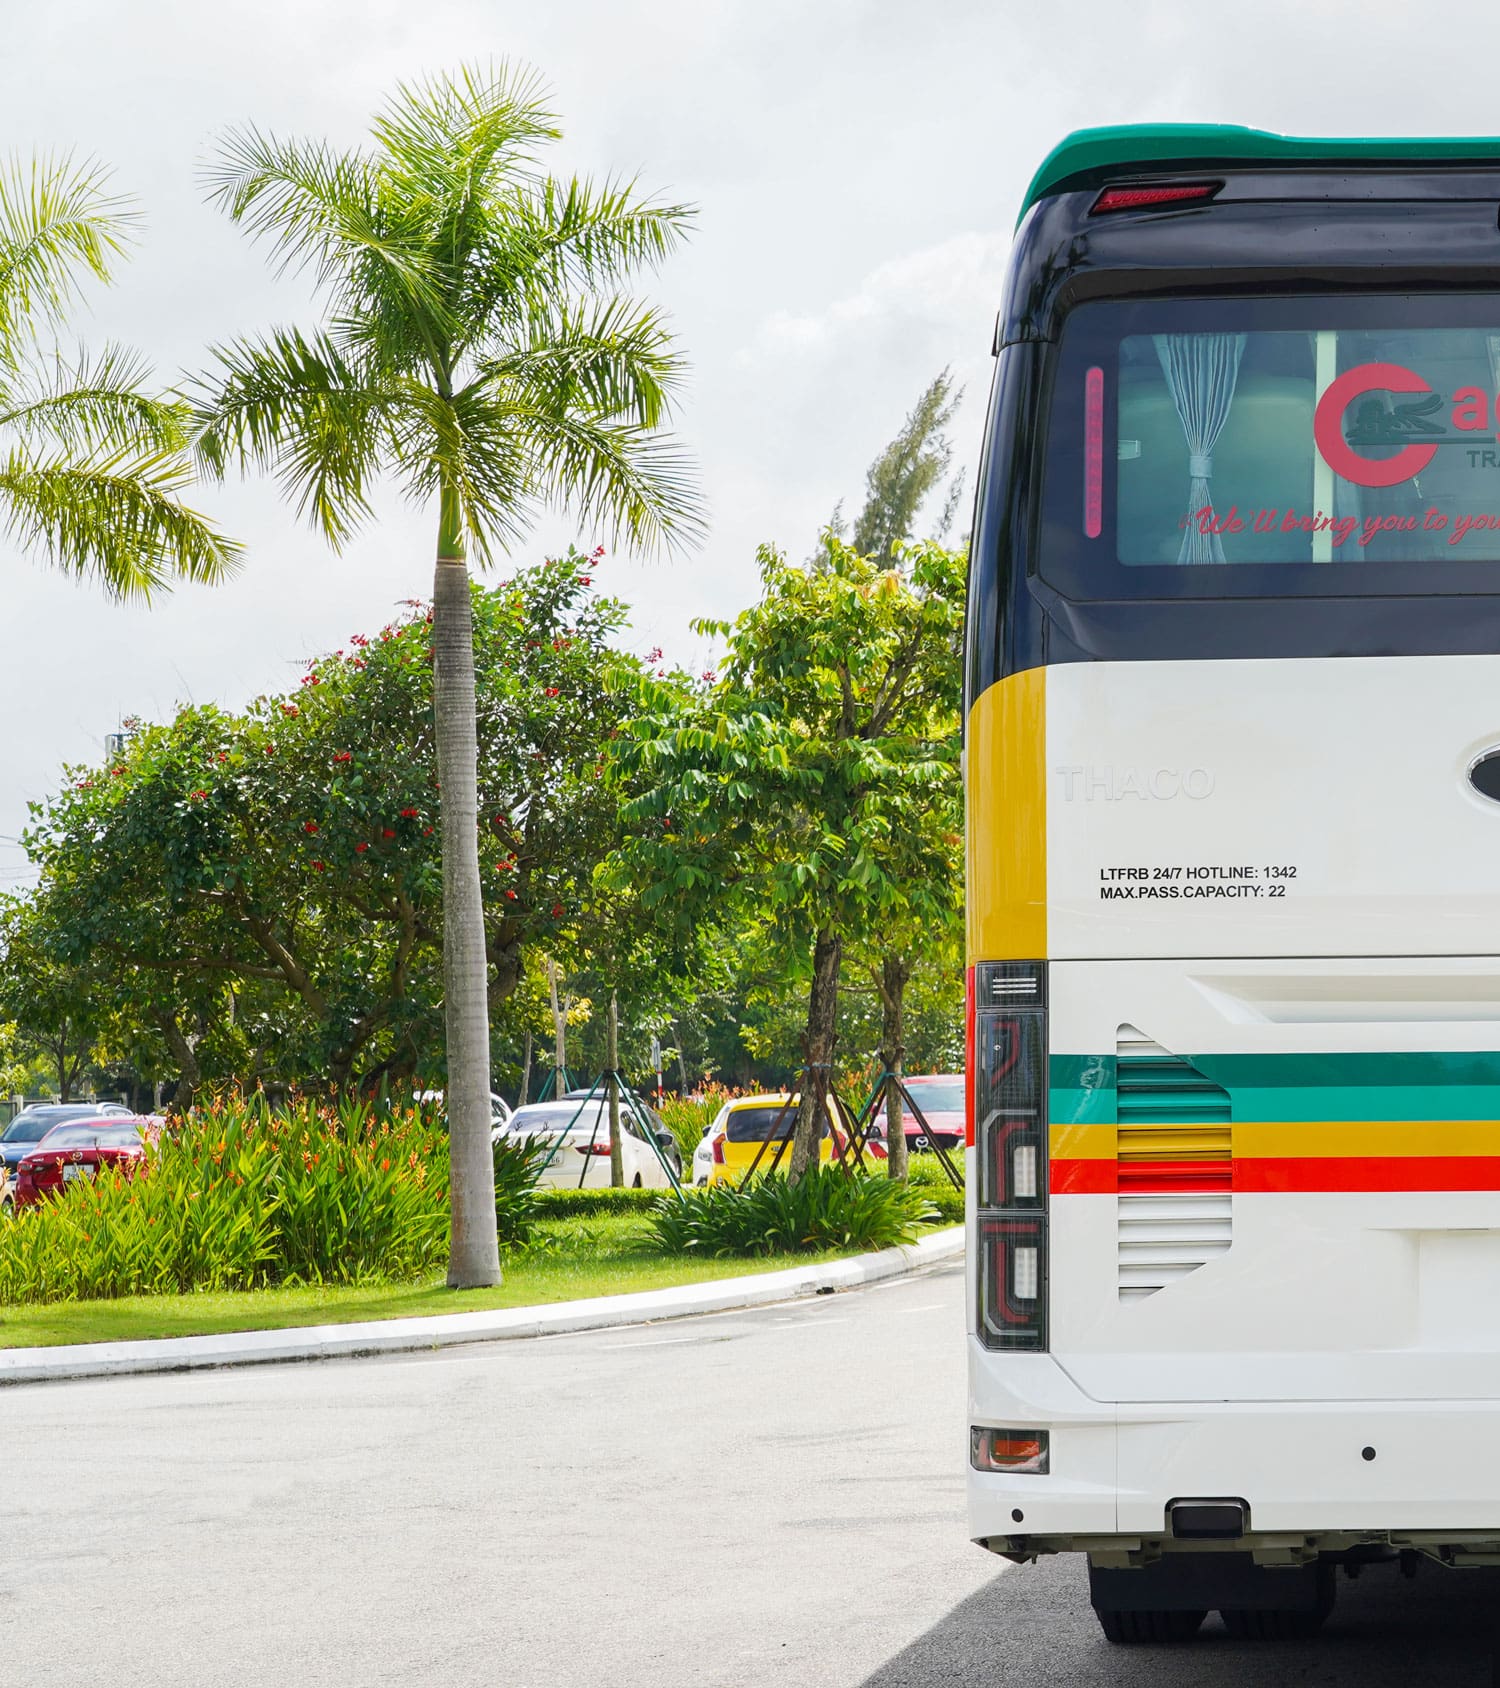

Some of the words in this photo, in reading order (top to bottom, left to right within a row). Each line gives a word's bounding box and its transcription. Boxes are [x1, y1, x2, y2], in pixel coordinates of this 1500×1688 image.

[1280, 508, 1360, 548] bring
[1358, 514, 1421, 546] you
[1421, 505, 1450, 531] to
[1056, 765, 1216, 802] THACO
[1100, 868, 1149, 881] LTFRB
[1153, 867, 1182, 880] 24/7
[1186, 866, 1259, 879] HOTLINE:
[1263, 866, 1297, 879] 1342
[1100, 885, 1264, 899] MAX.PASS.CAPACITY:
[1268, 885, 1286, 898] 22
